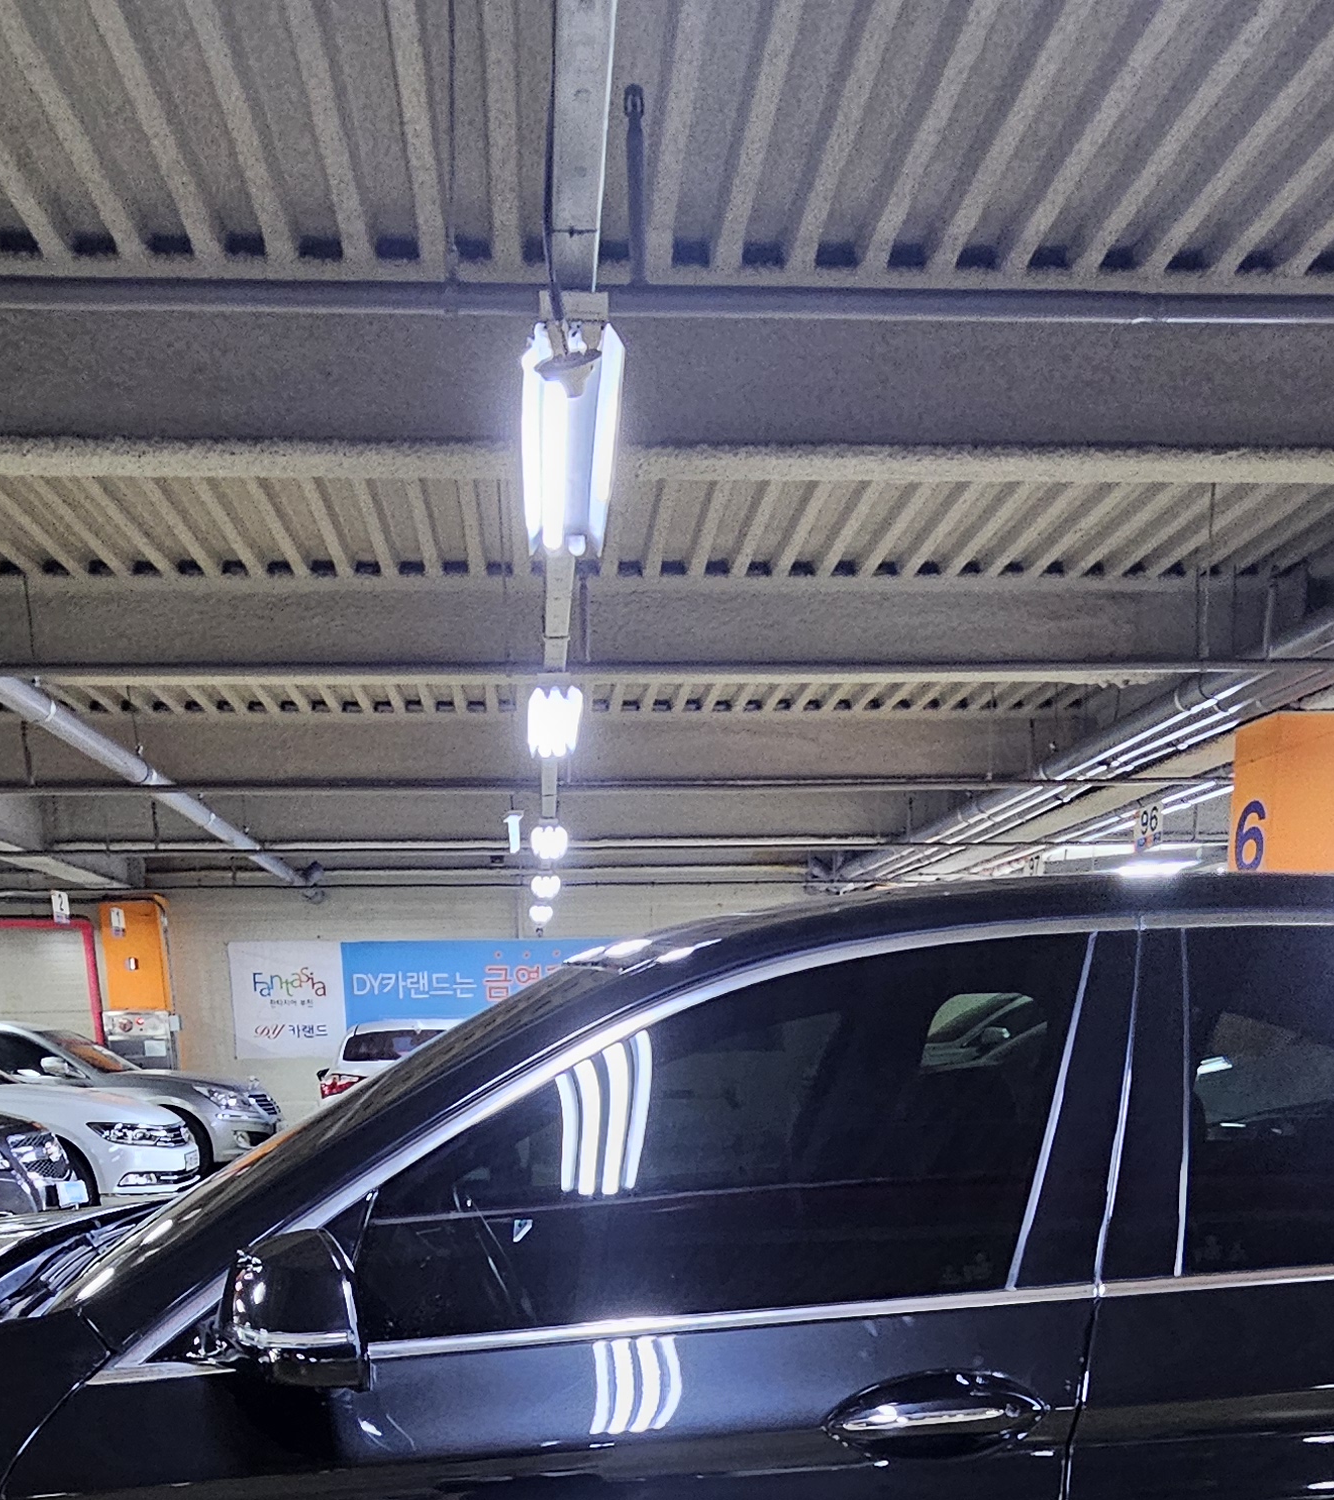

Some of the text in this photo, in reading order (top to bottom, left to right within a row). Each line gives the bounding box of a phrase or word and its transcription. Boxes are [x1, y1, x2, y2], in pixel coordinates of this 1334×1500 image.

[1140, 806, 1159, 834] 96
[1235, 800, 1266, 872] 6
[252, 967, 327, 997] Fantasia
[352, 970, 477, 999] DY카랜드는
[288, 1024, 328, 1039] 카랜드
